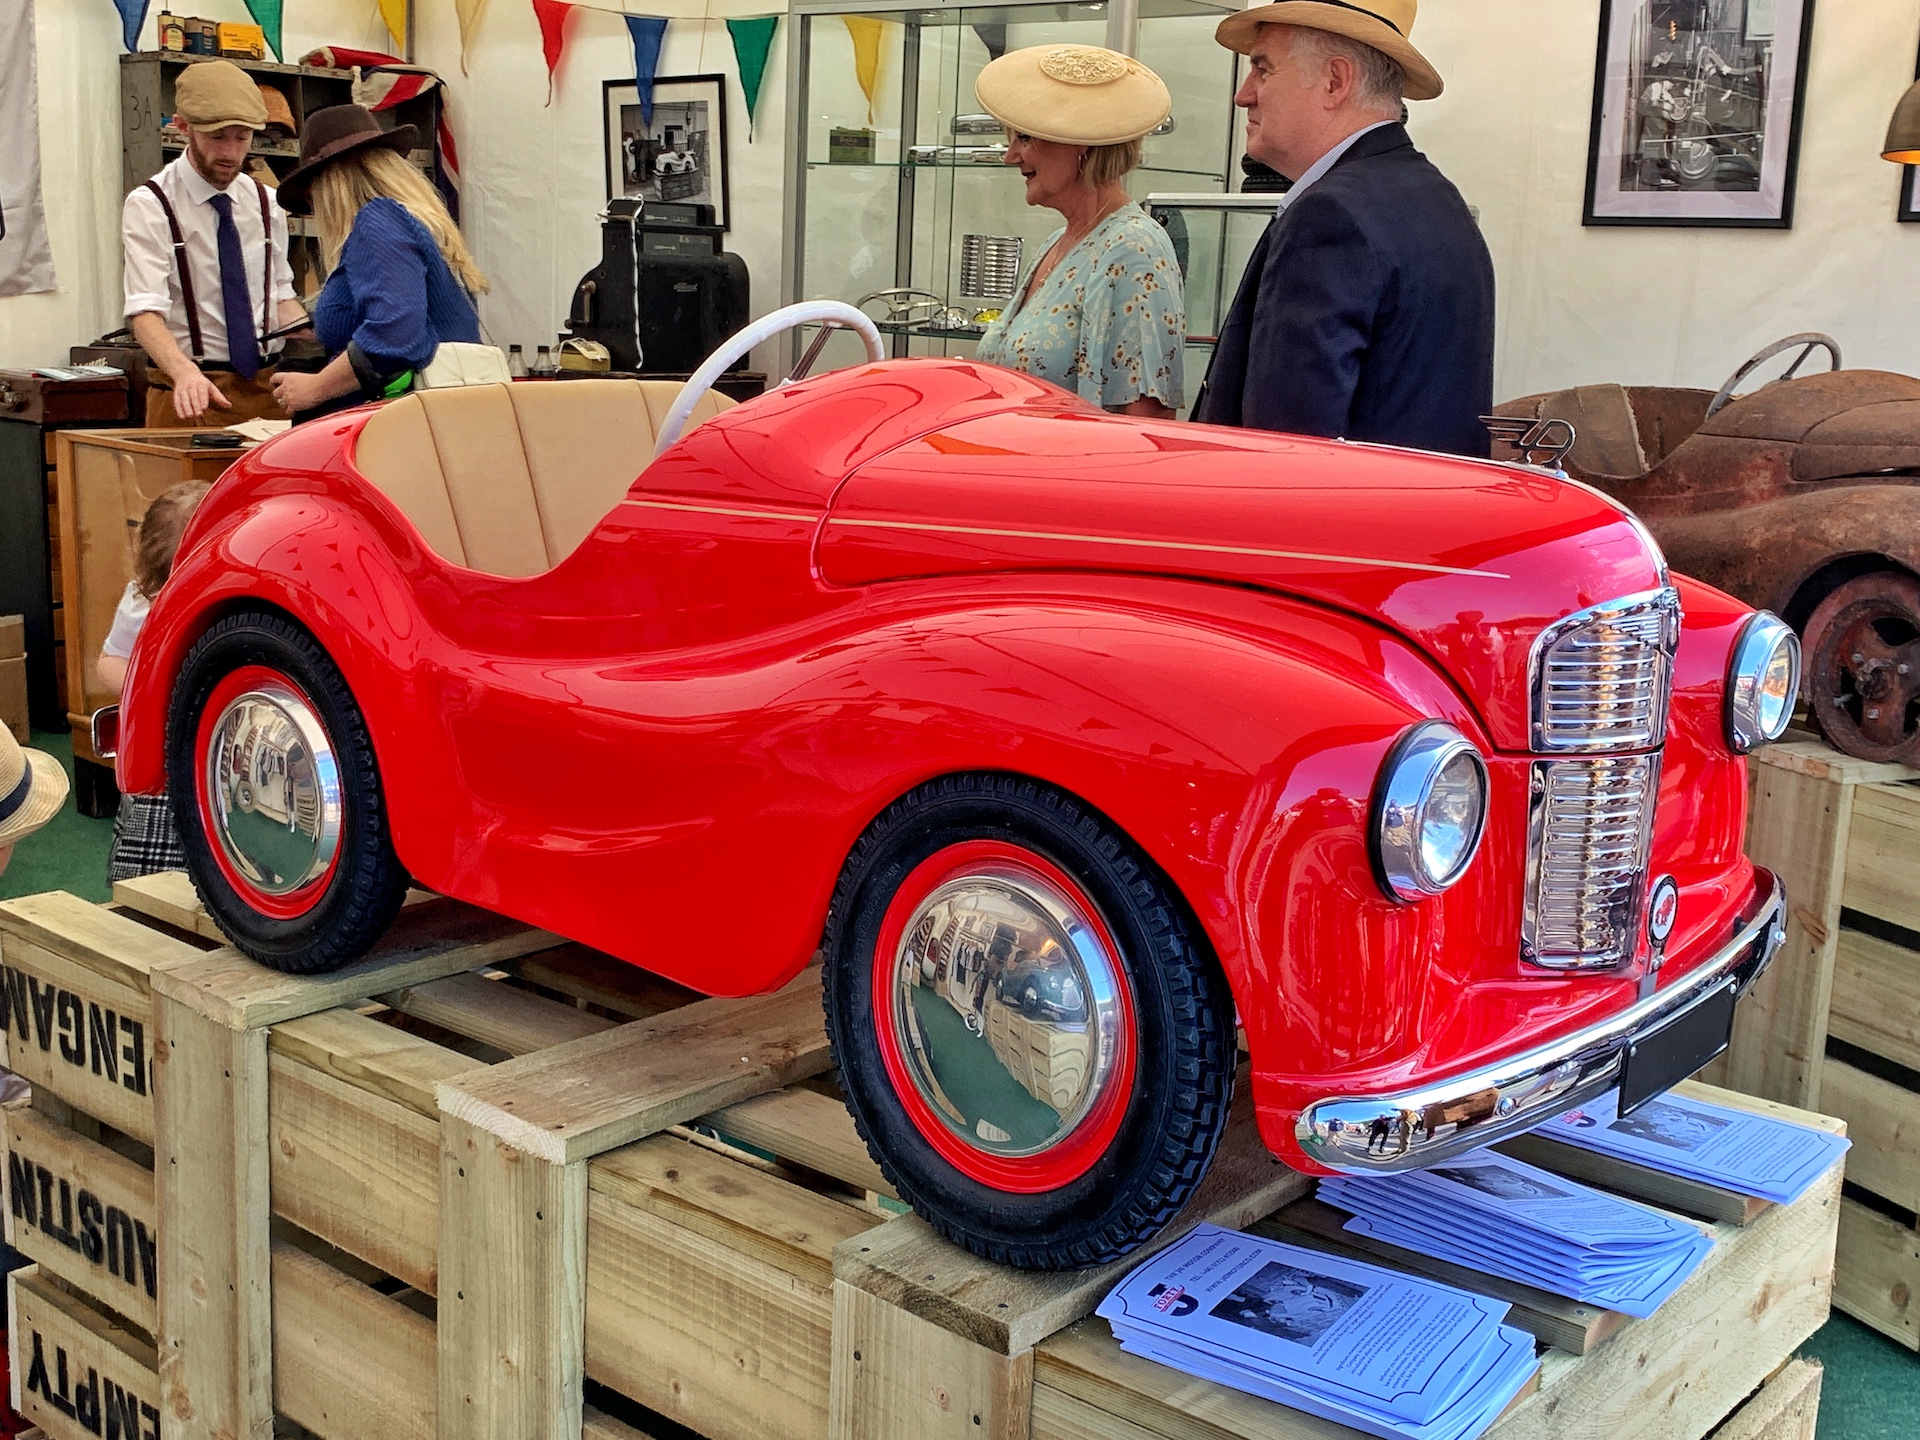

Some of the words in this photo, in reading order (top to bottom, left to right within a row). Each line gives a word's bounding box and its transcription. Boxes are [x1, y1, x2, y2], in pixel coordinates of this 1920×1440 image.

[0, 963, 154, 1097] ENGAM
[9, 1150, 156, 1301] AUSTIN
[1154, 1287, 1178, 1309] FORTY
